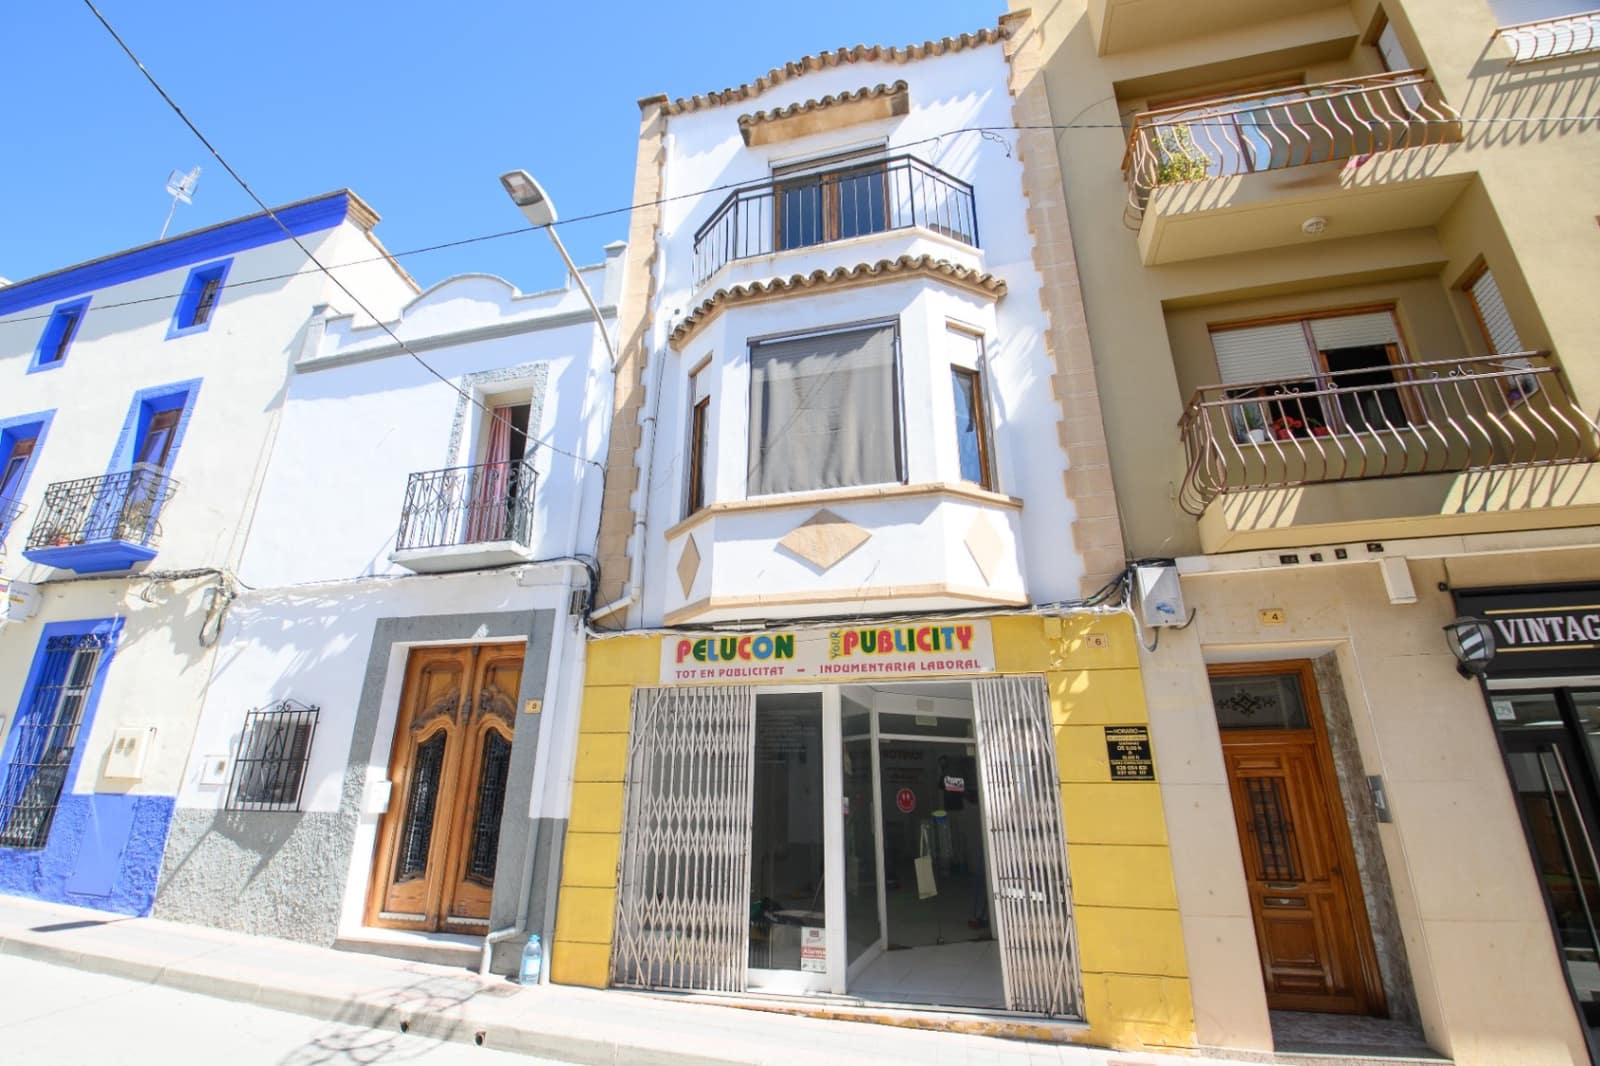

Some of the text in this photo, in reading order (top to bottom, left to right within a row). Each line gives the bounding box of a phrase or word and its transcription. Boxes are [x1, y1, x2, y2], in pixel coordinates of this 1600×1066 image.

[676, 634, 794, 664] PELUCON
[831, 625, 972, 658] YOUR PUBLICITY
[676, 670, 697, 679] TOT
[700, 669, 715, 678] EN
[718, 666, 785, 677] PUBLICITAT
[820, 661, 917, 673] INDUMENTARIA
[920, 659, 981, 671] LABORAL
